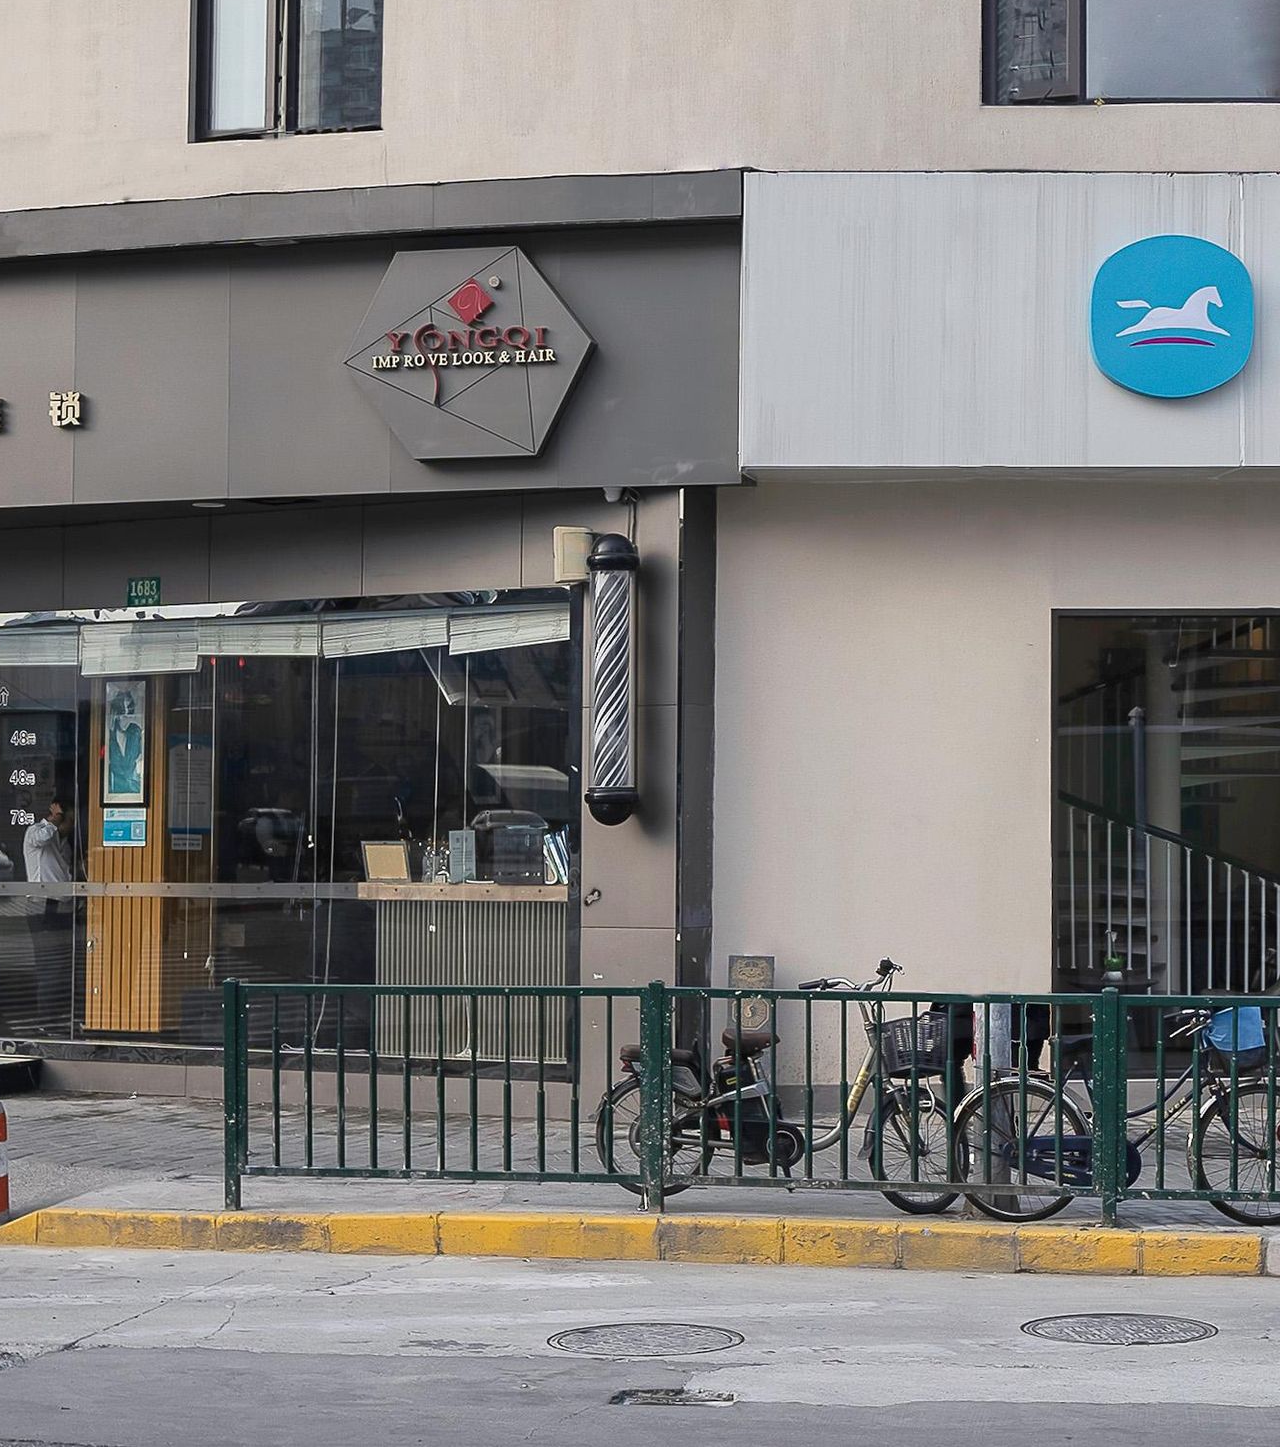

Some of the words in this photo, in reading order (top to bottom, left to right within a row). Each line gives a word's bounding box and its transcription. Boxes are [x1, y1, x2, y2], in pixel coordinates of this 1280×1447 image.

[386, 322, 549, 352] YONGQI
[452, 351, 496, 366] LOOK
[499, 350, 511, 364] &
[515, 348, 556, 364] HAIR
[130, 580, 157, 596] 1683
[10, 730, 36, 746] 48元
[9, 770, 36, 785] 48元
[10, 809, 35, 825] 78元
